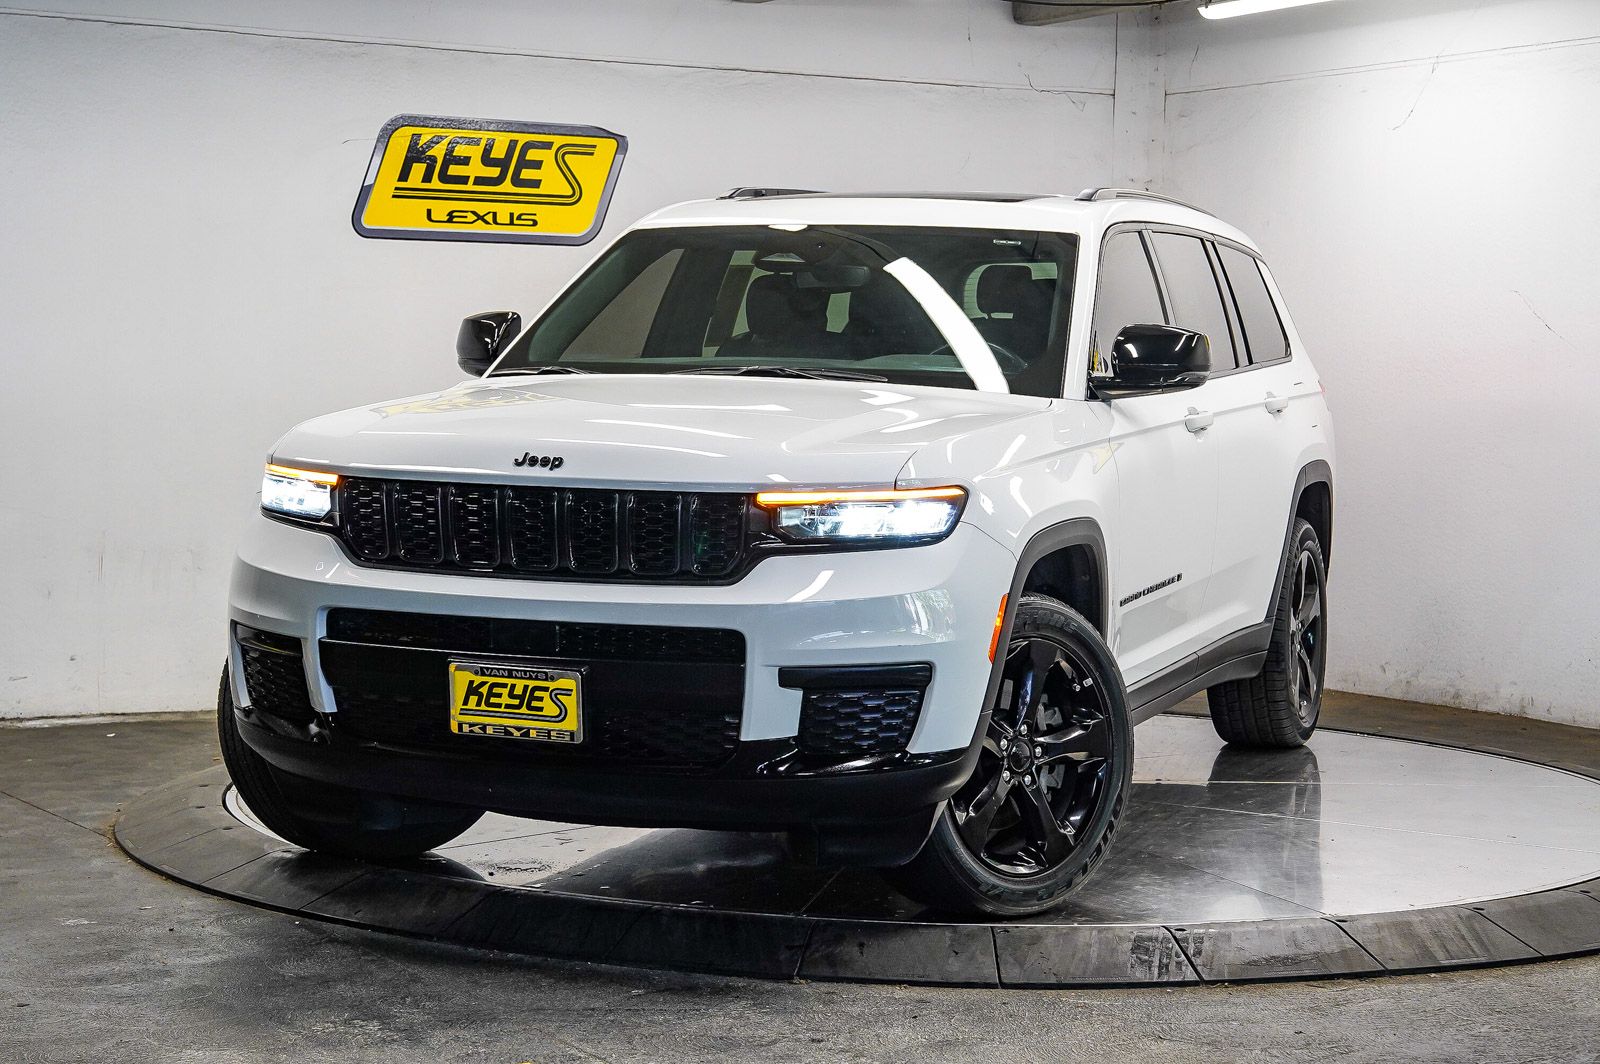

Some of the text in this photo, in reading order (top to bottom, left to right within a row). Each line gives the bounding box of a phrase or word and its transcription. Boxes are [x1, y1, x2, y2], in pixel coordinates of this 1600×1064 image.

[392, 133, 597, 206] KEYES
[426, 208, 538, 227] LEXUS
[514, 452, 564, 471] Jeep
[483, 668, 546, 679] VAN NUYS
[459, 680, 573, 723] KEYES
[462, 724, 571, 741] KEYES
